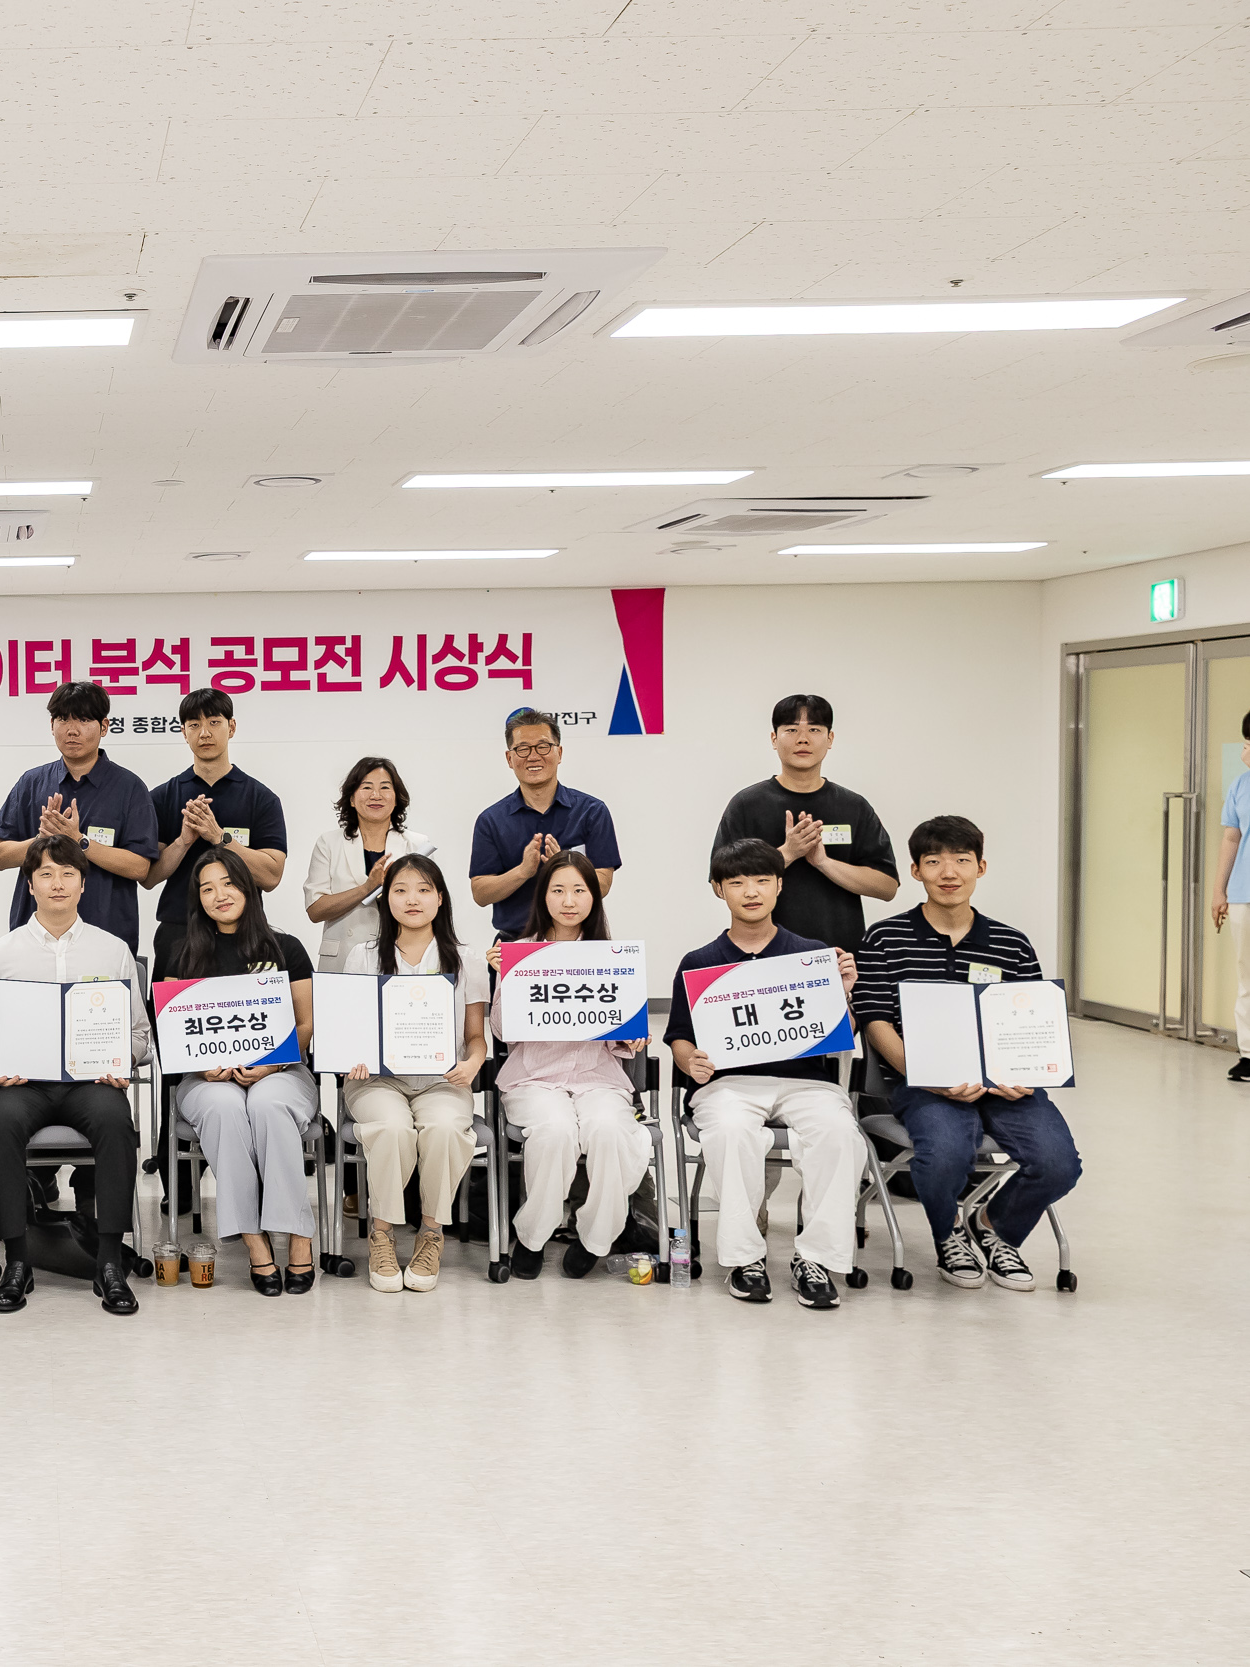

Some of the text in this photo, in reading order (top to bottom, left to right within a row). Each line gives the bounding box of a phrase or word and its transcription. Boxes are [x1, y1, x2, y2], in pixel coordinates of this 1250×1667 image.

[89, 637, 191, 697] 분석
[207, 634, 362, 695] 공모전
[379, 632, 533, 692] 시상식
[108, 716, 125, 734] 청
[514, 969, 540, 977] 2025년
[566, 968, 595, 976] 빅데이터
[596, 968, 611, 976] 분석
[612, 967, 635, 975] 공모전
[529, 983, 619, 1003] 최우수상
[703, 978, 830, 1004] 2025년 광진구 빅데이터 분석 공모전
[168, 996, 282, 1013] 2025년 광진구 빅데이터 분석 공모전
[184, 1011, 268, 1036] 최우수상
[528, 1009, 623, 1026] 1,000,000원
[185, 1035, 276, 1057] 1,000,000원
[724, 1021, 826, 1051] 3,000,000원
